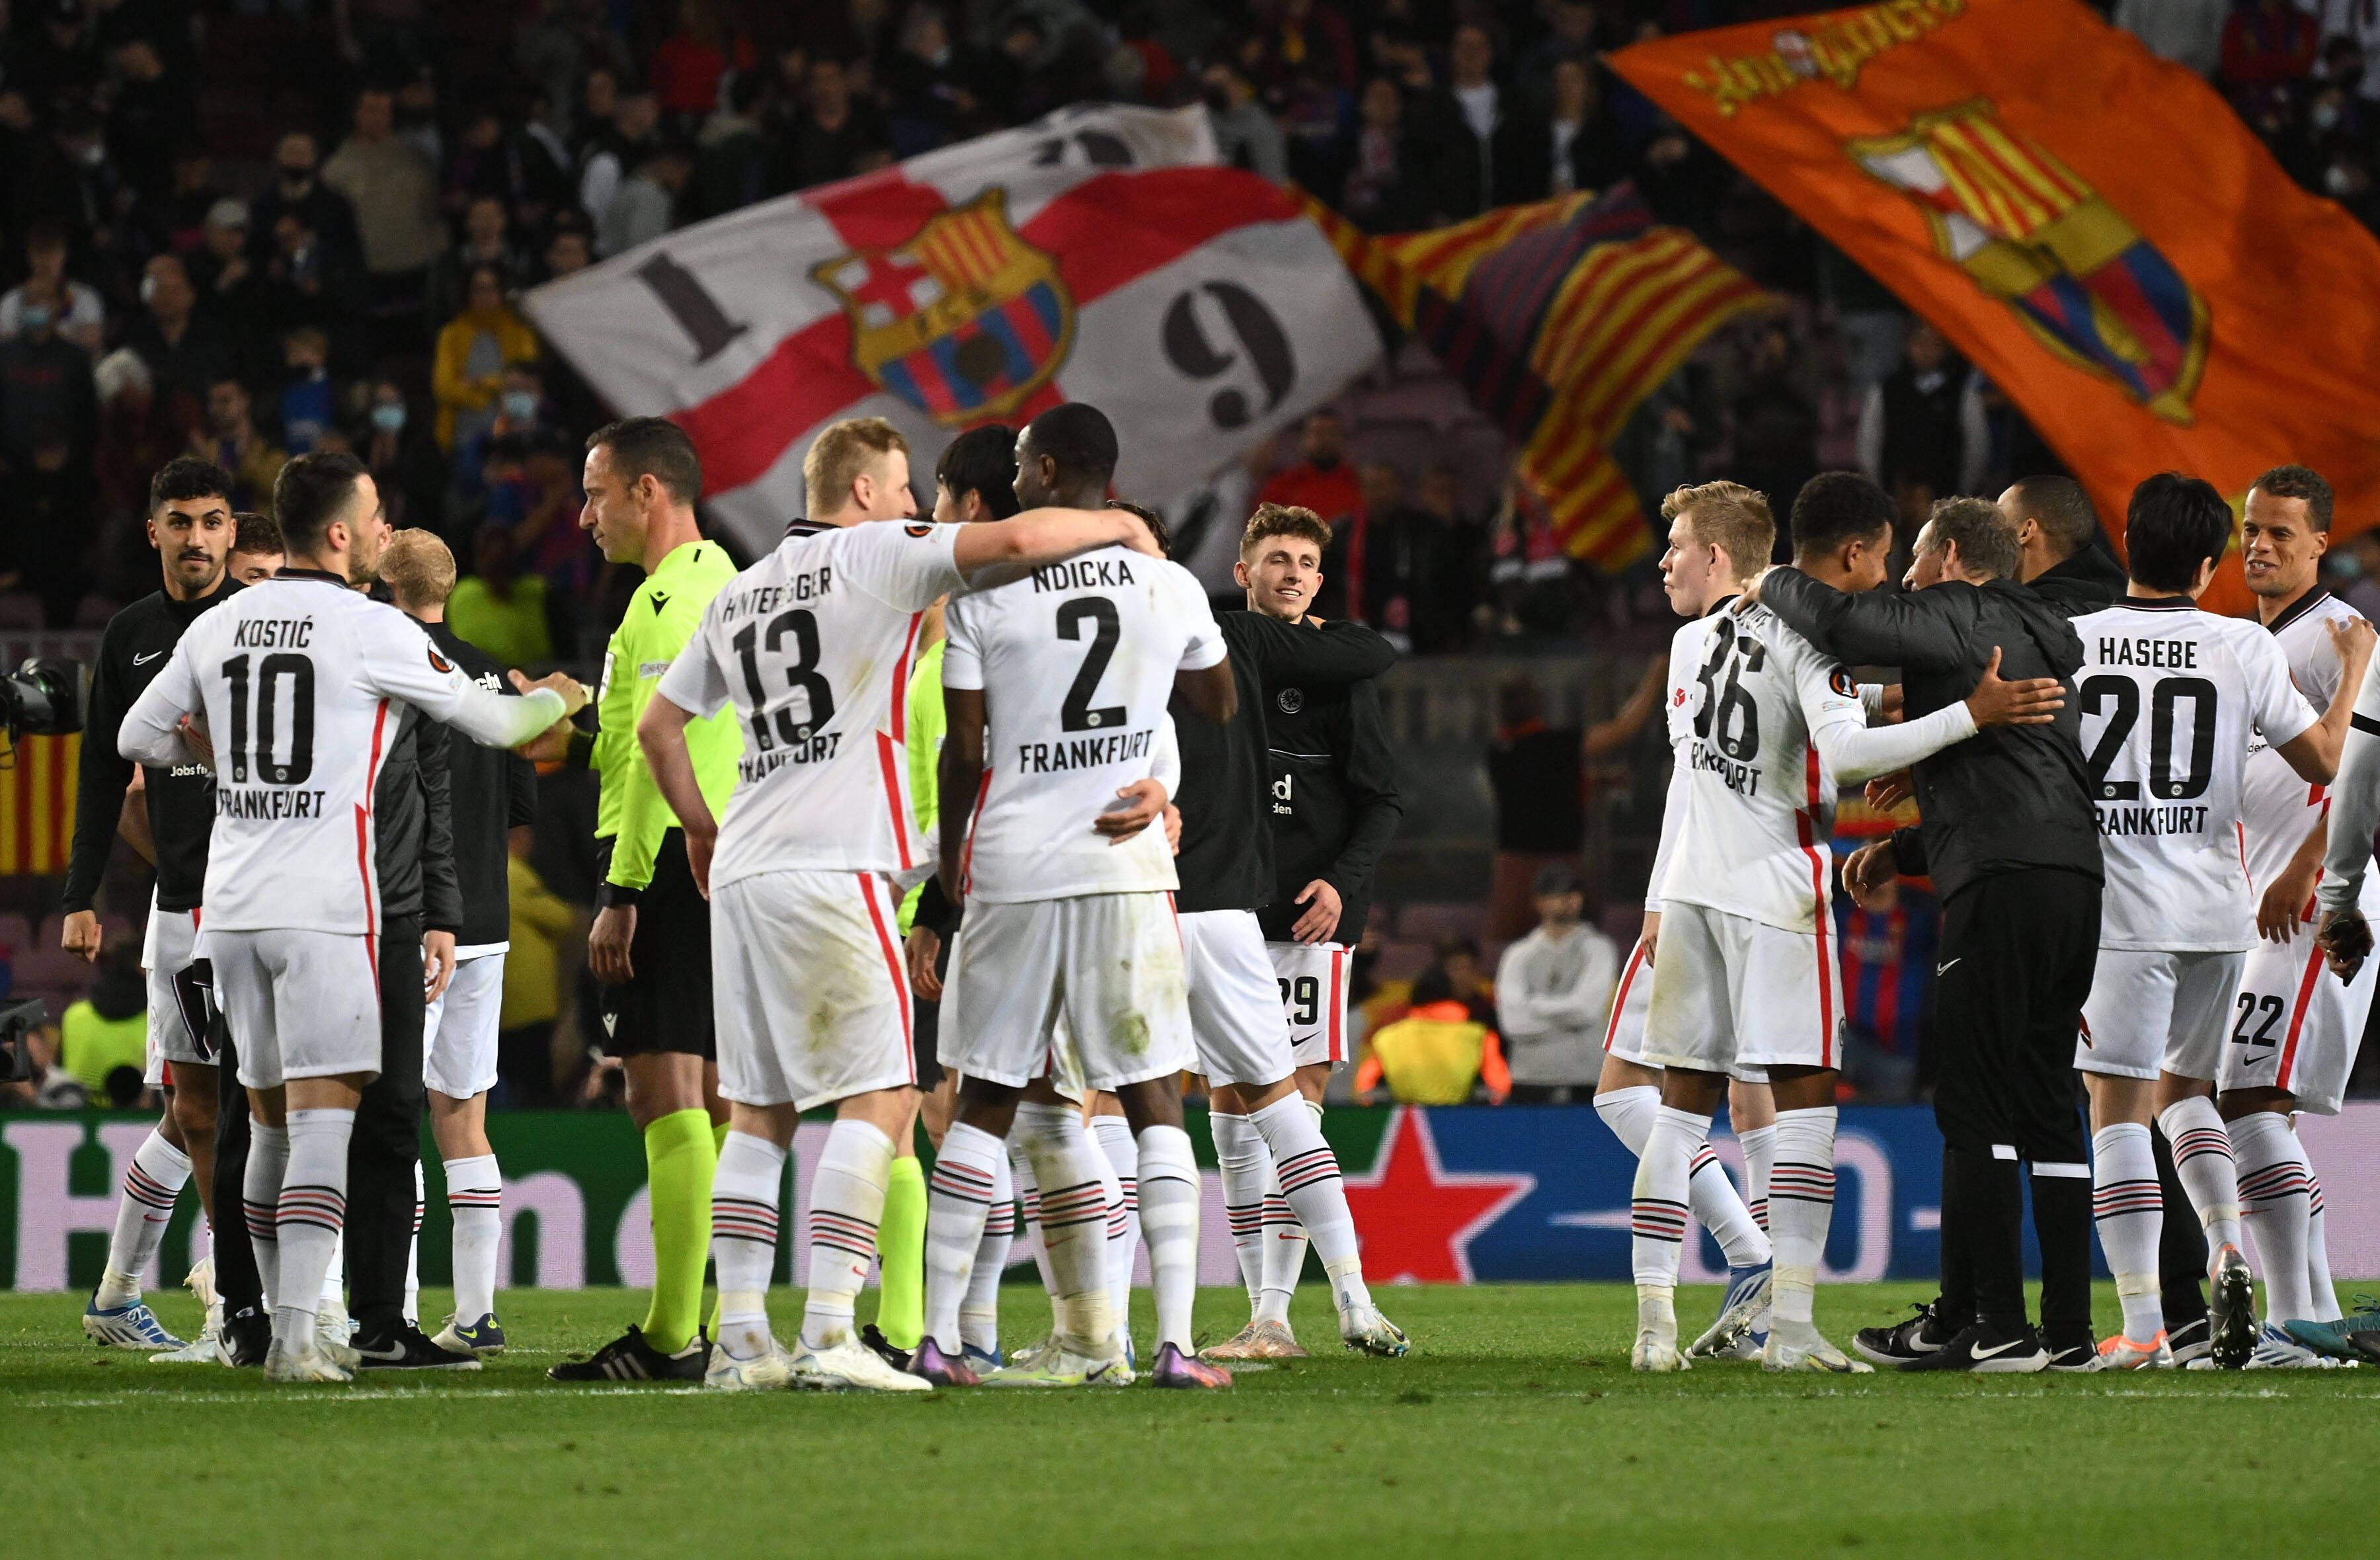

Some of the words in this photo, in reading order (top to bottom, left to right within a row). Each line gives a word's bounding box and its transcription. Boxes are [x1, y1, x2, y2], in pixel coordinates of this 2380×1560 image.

[1031, 560, 1135, 594] NDICKA
[233, 615, 313, 648] KOSTIĆ
[2100, 637, 2198, 669] HASEBE
[733, 608, 836, 752] 13
[1056, 596, 1128, 733] 2
[222, 653, 315, 786] 10
[2080, 675, 2218, 801] 20
[171, 764, 196, 777] Jobs
[1019, 729, 1154, 774] FRANKFURT
[2094, 806, 2209, 837] RANKFURT
[2231, 992, 2285, 1047] 22
